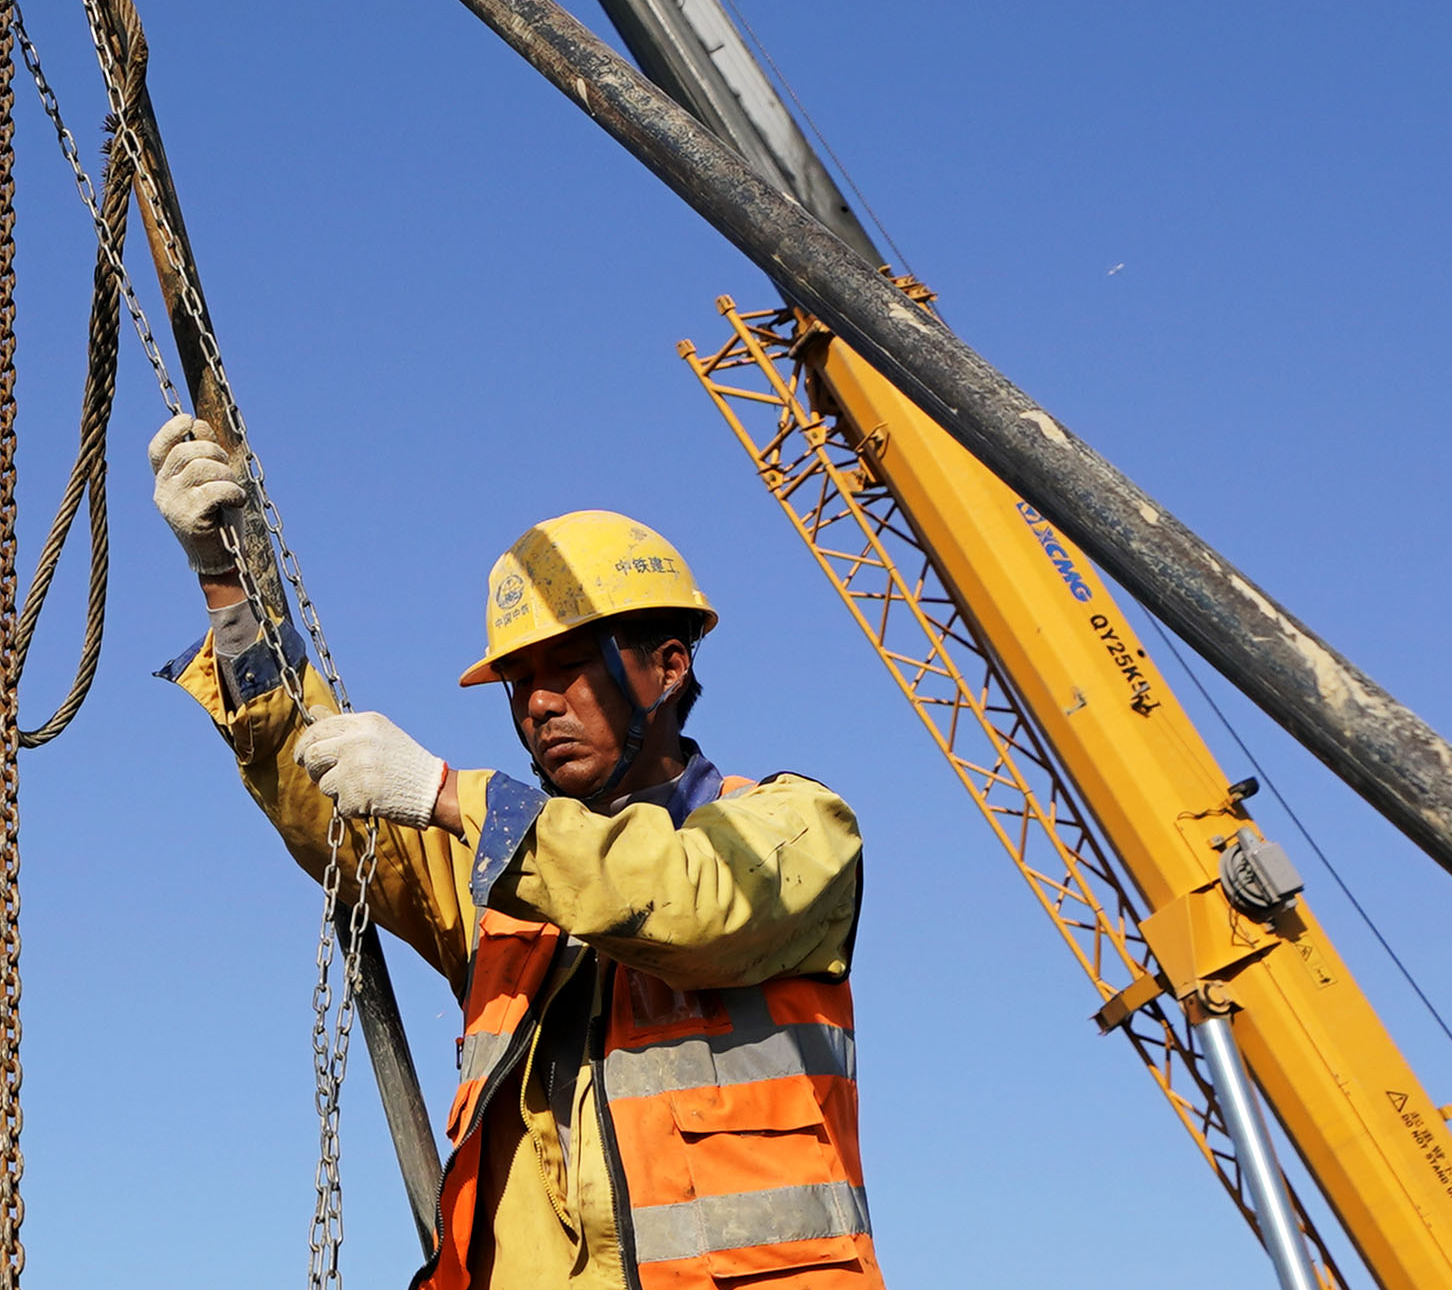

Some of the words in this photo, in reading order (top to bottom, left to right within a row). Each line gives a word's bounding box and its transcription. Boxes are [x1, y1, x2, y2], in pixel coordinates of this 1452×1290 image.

[615, 556, 680, 576] 中铁建工
[1033, 527, 1092, 602] XCMG
[1401, 1113, 1414, 1129] DO
[1411, 1129, 1429, 1150] NOT
[1425, 1152, 1450, 1185] STAND
